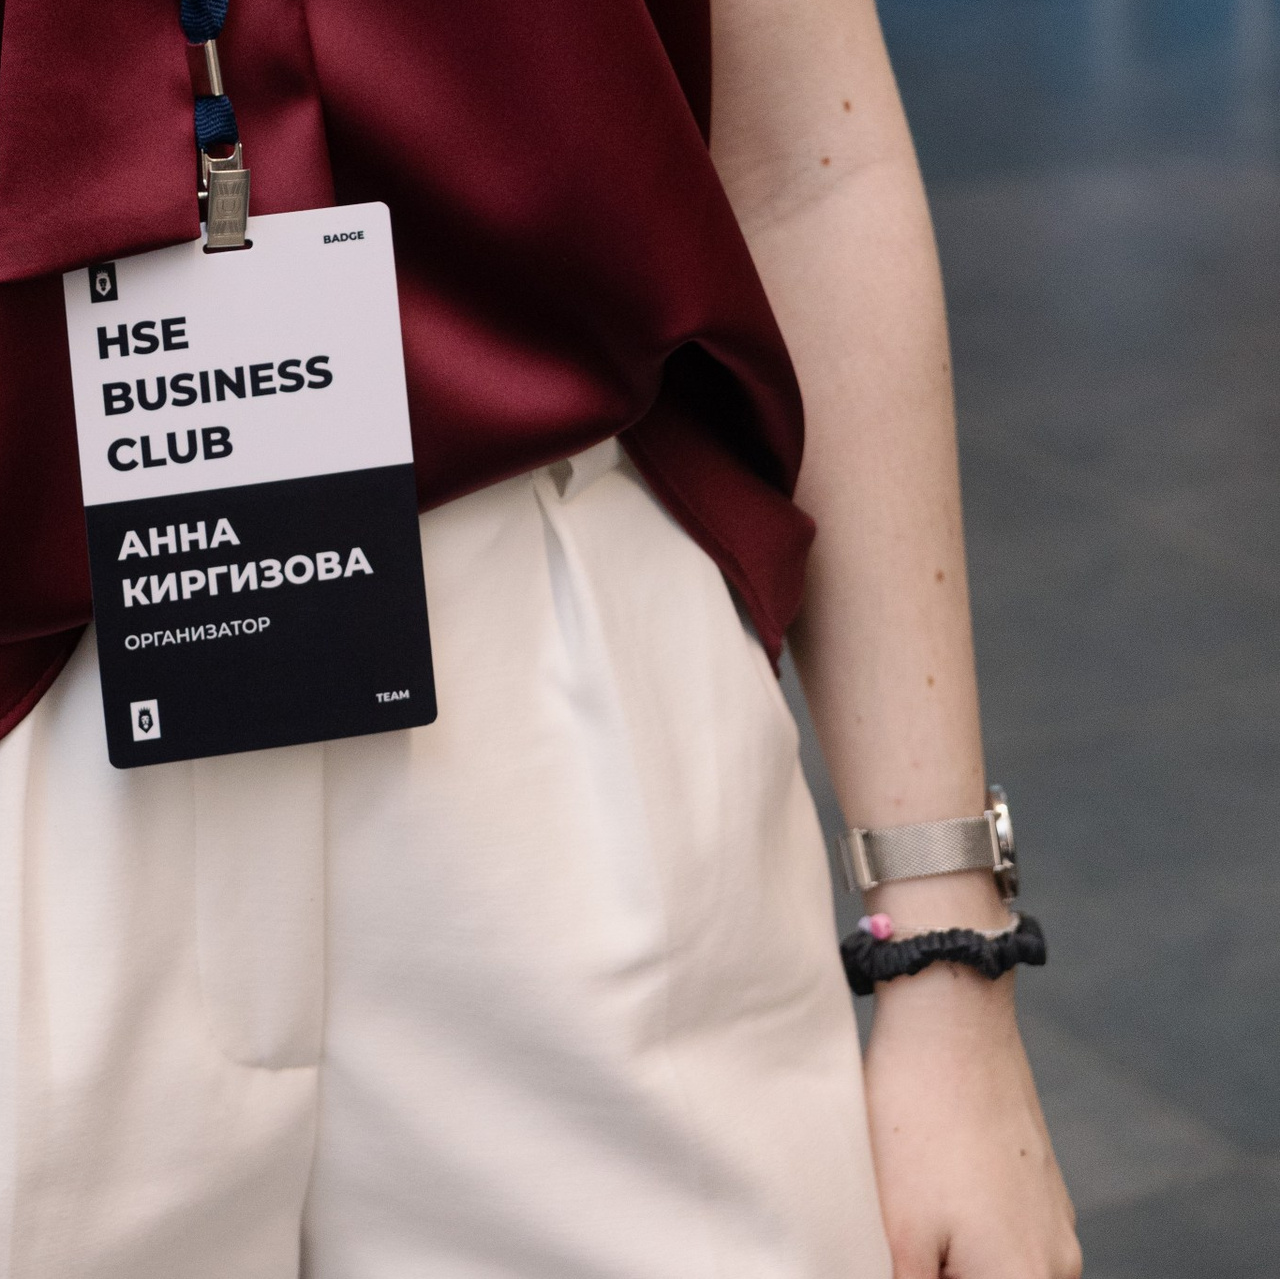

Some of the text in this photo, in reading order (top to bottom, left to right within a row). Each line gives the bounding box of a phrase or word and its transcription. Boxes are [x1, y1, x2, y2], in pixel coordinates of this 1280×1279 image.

[323, 230, 365, 244] BADGE
[96, 316, 189, 360] HSE
[102, 355, 333, 416] BUSINESS
[107, 425, 233, 472] CLUB
[117, 517, 241, 561] АННА
[122, 546, 374, 608] КИРГИЗОВА
[124, 616, 271, 650] ОРГАНИЗАТОР
[375, 689, 410, 703] TEAM
